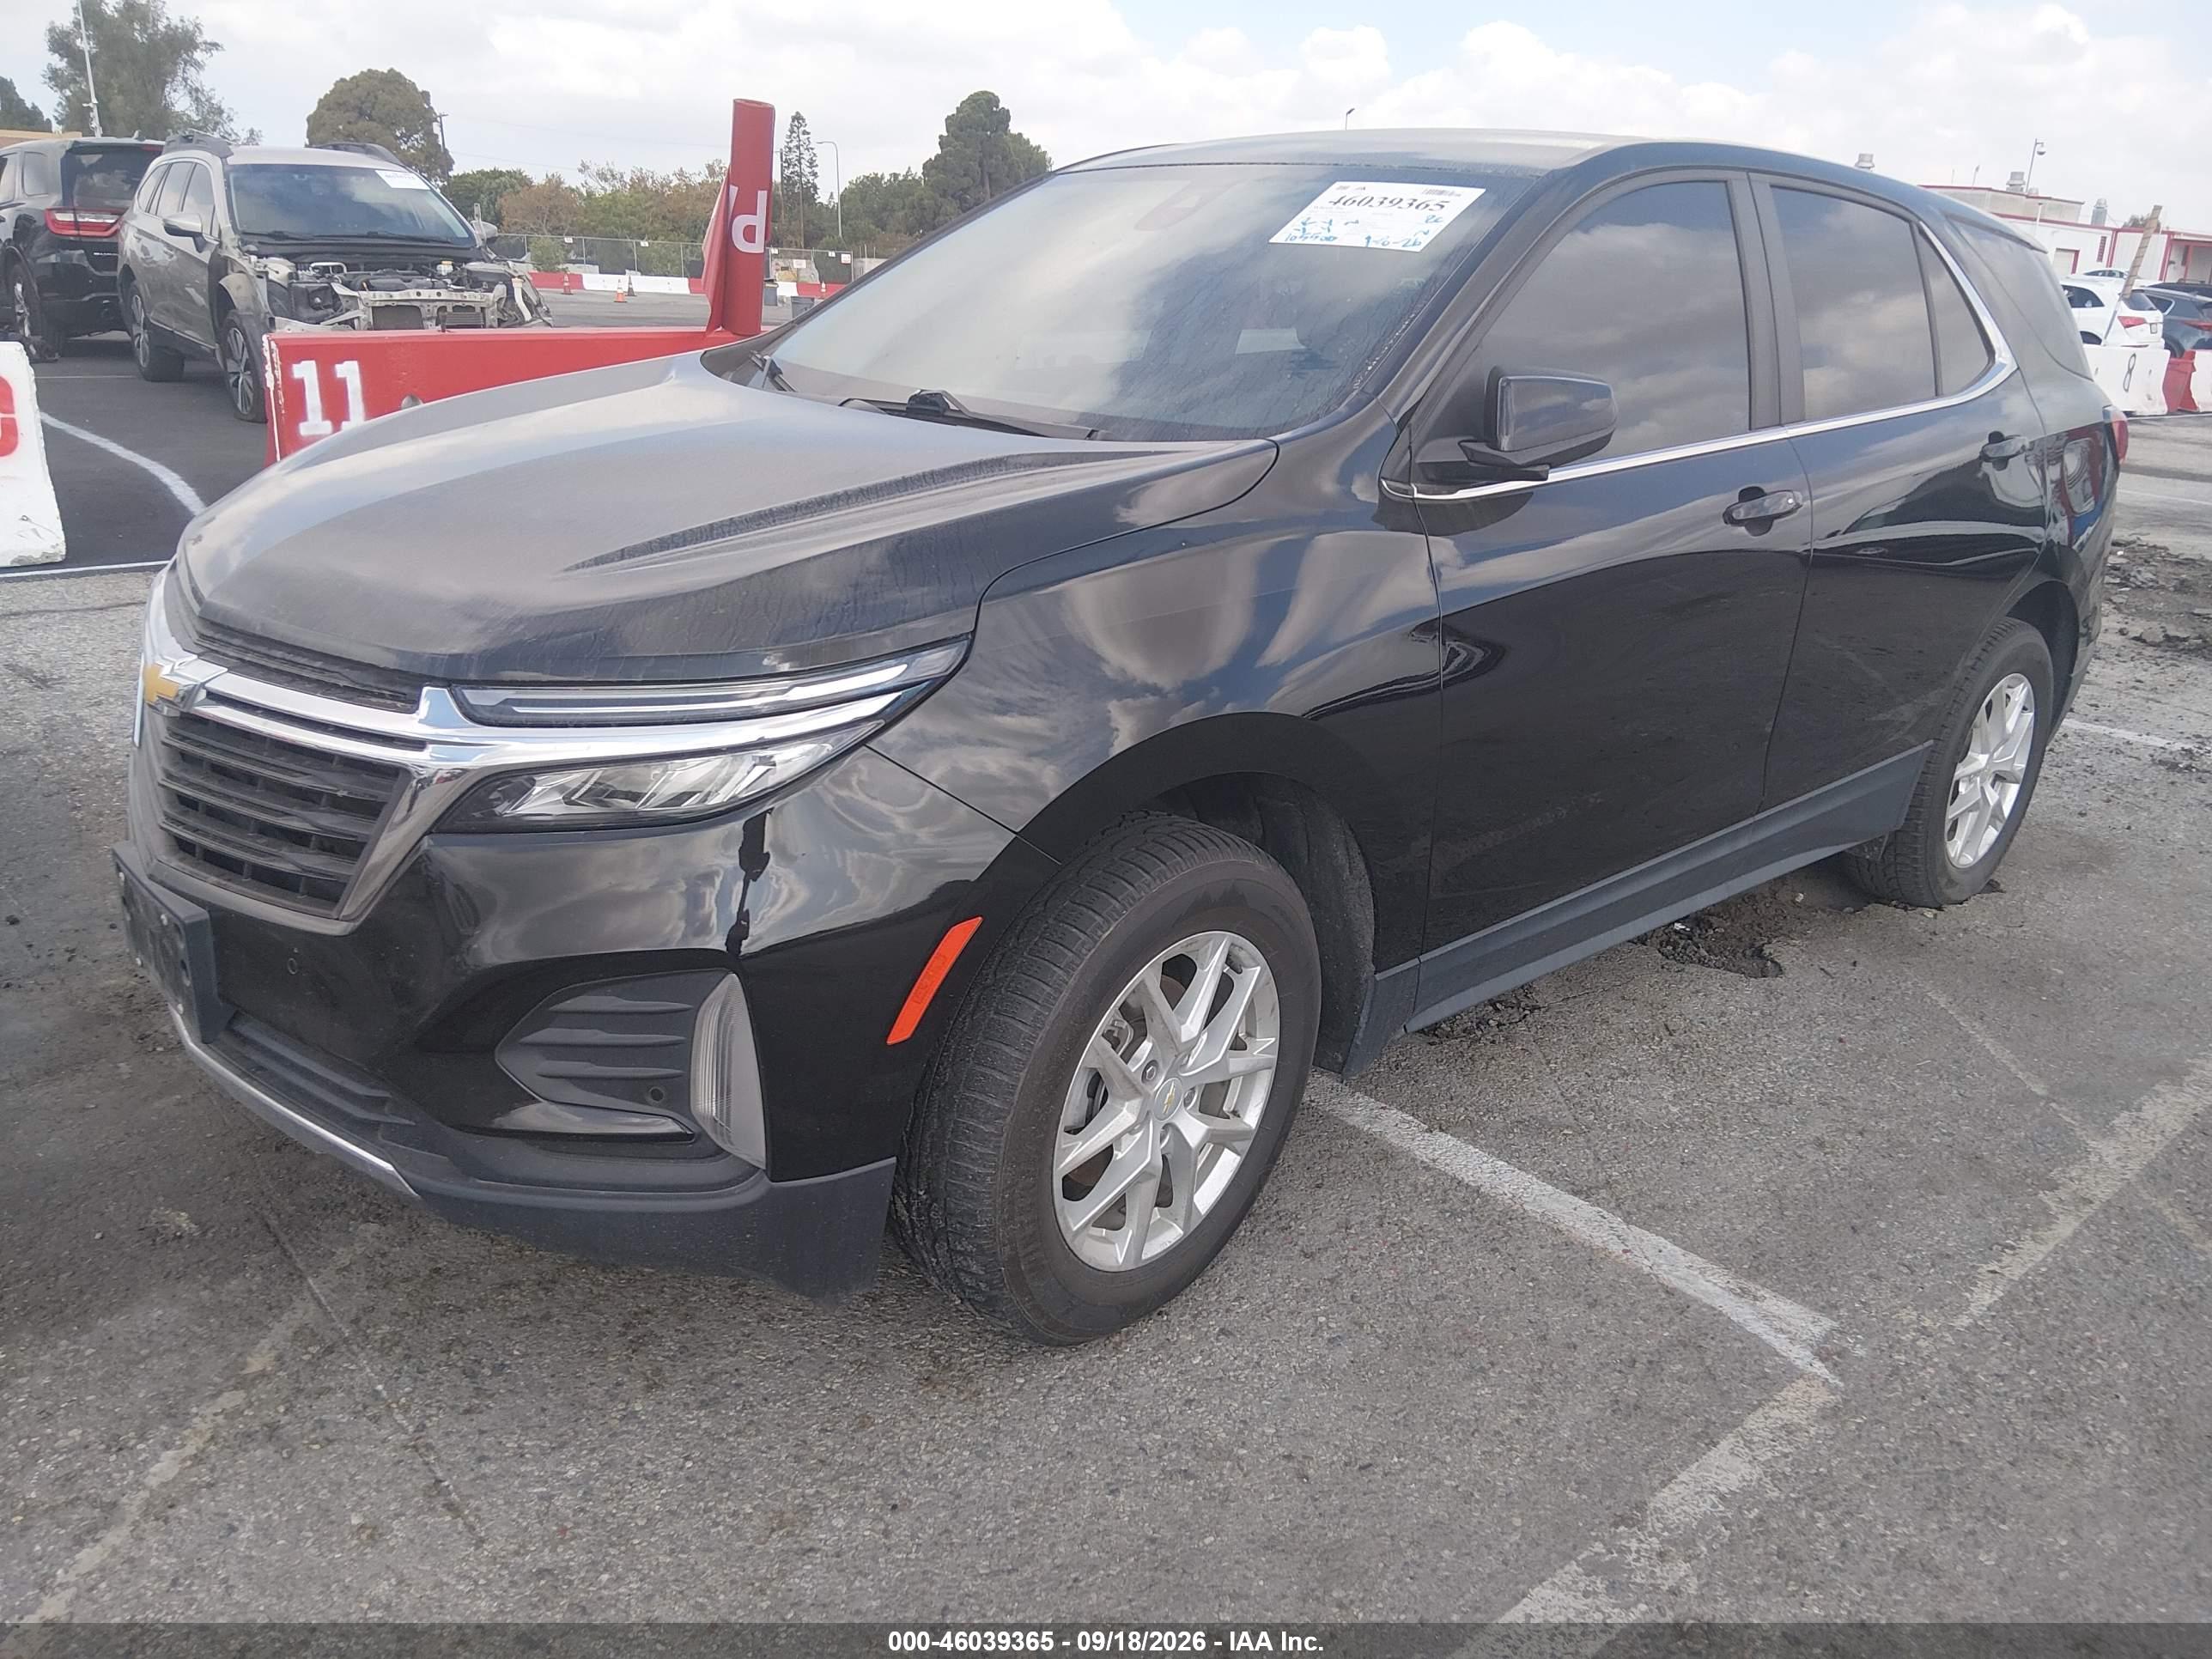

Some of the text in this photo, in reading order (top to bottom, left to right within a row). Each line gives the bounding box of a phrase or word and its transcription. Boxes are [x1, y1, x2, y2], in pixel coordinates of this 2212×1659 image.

[1328, 194, 1450, 211] 46039365
[2123, 353, 2136, 392] 8
[291, 360, 366, 436] 11
